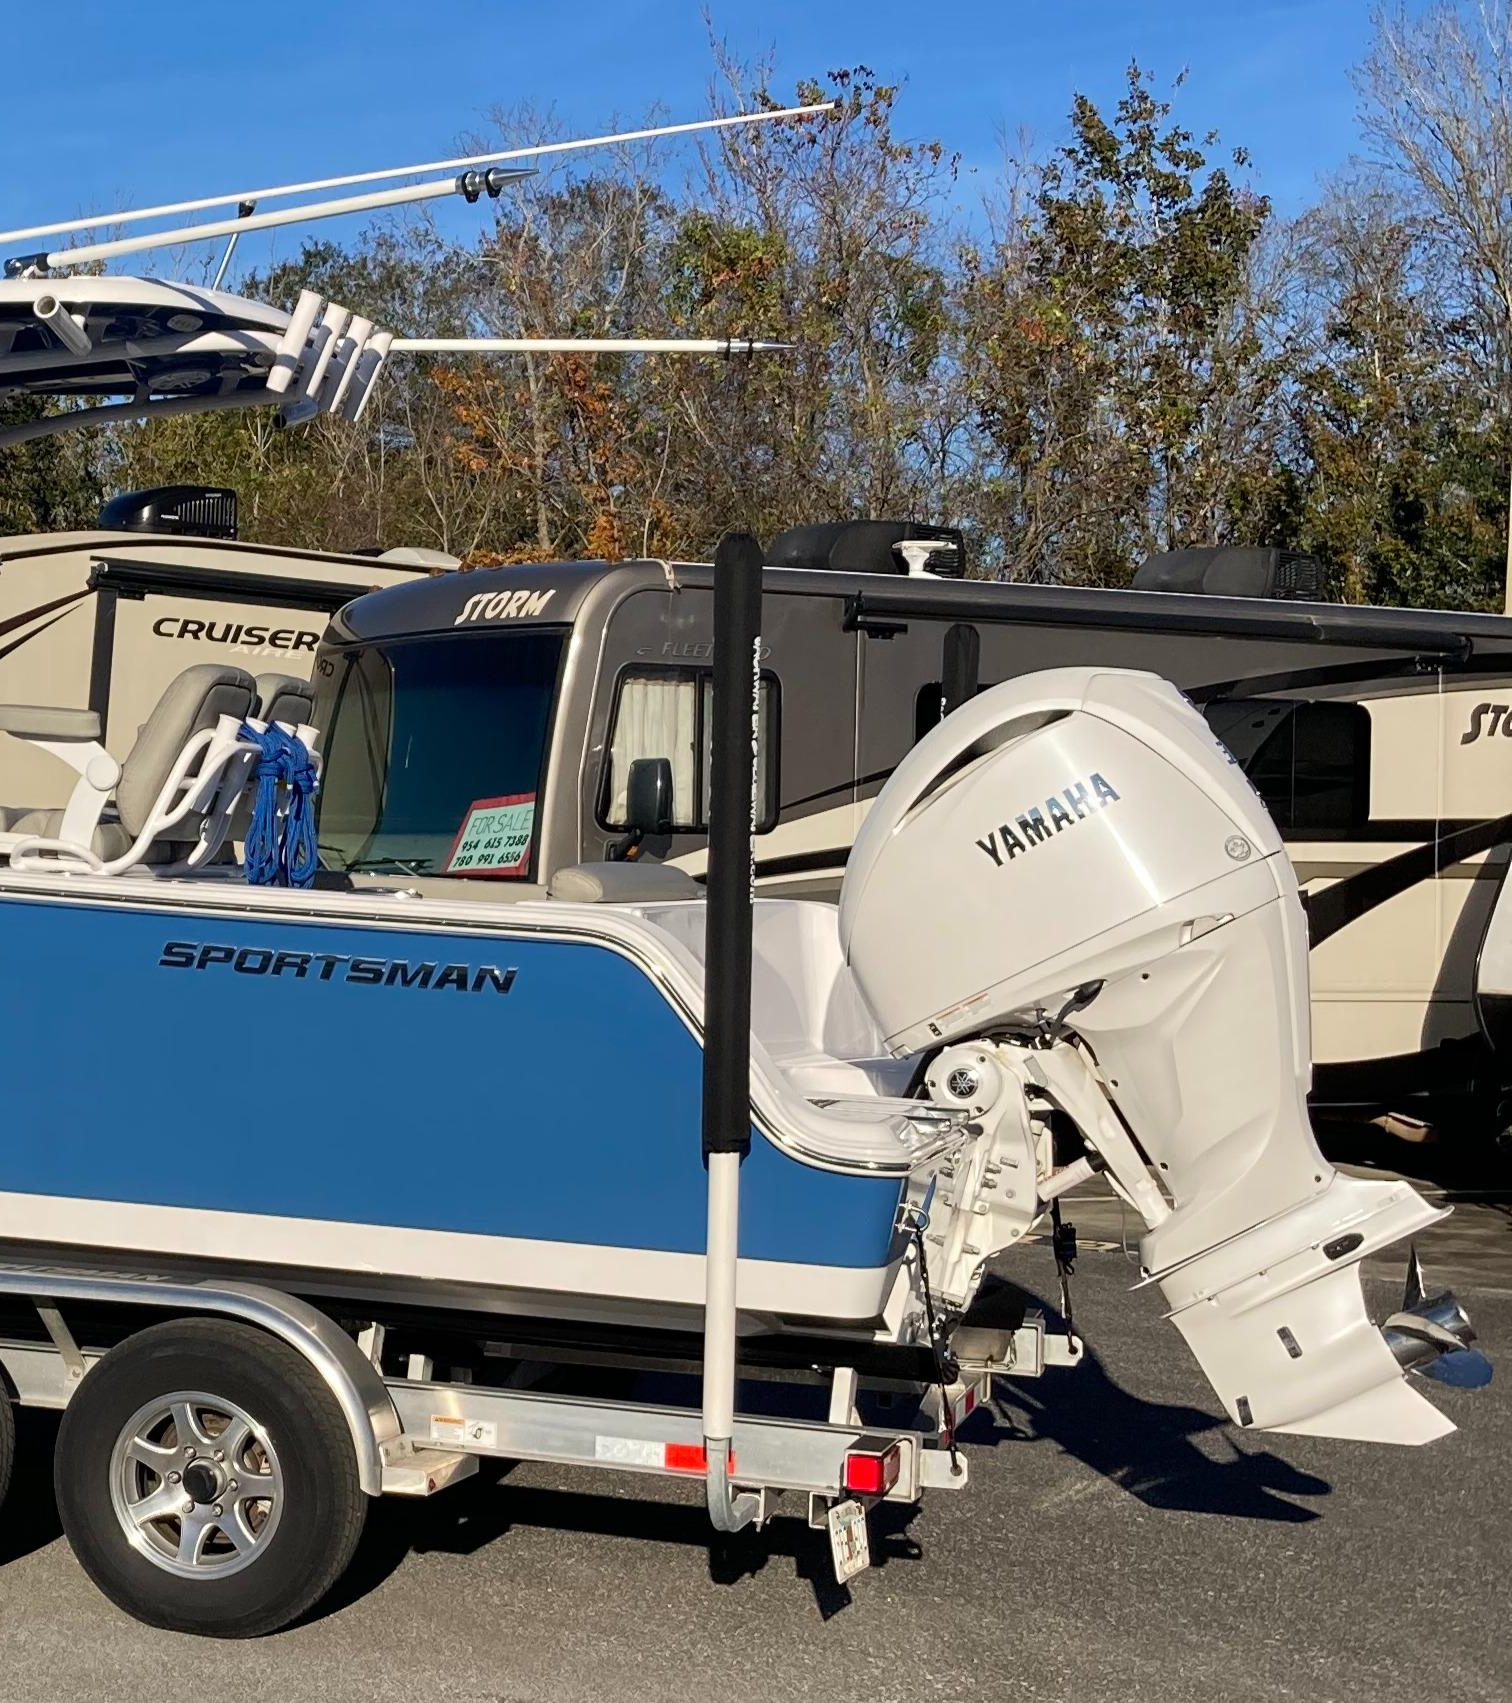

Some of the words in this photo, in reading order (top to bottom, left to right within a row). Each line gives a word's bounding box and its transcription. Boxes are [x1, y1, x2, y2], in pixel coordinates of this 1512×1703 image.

[453, 588, 557, 626] STORM
[152, 617, 320, 651] CRUISER
[228, 645, 305, 660] AIRE
[661, 641, 771, 660] FLEETD
[468, 816, 495, 836] FOR
[492, 810, 534, 833] SALE
[975, 772, 1121, 867] YAMAHA
[462, 839, 480, 852] 954
[483, 835, 503, 849] 615
[159, 941, 519, 994] SPORTSMAN
